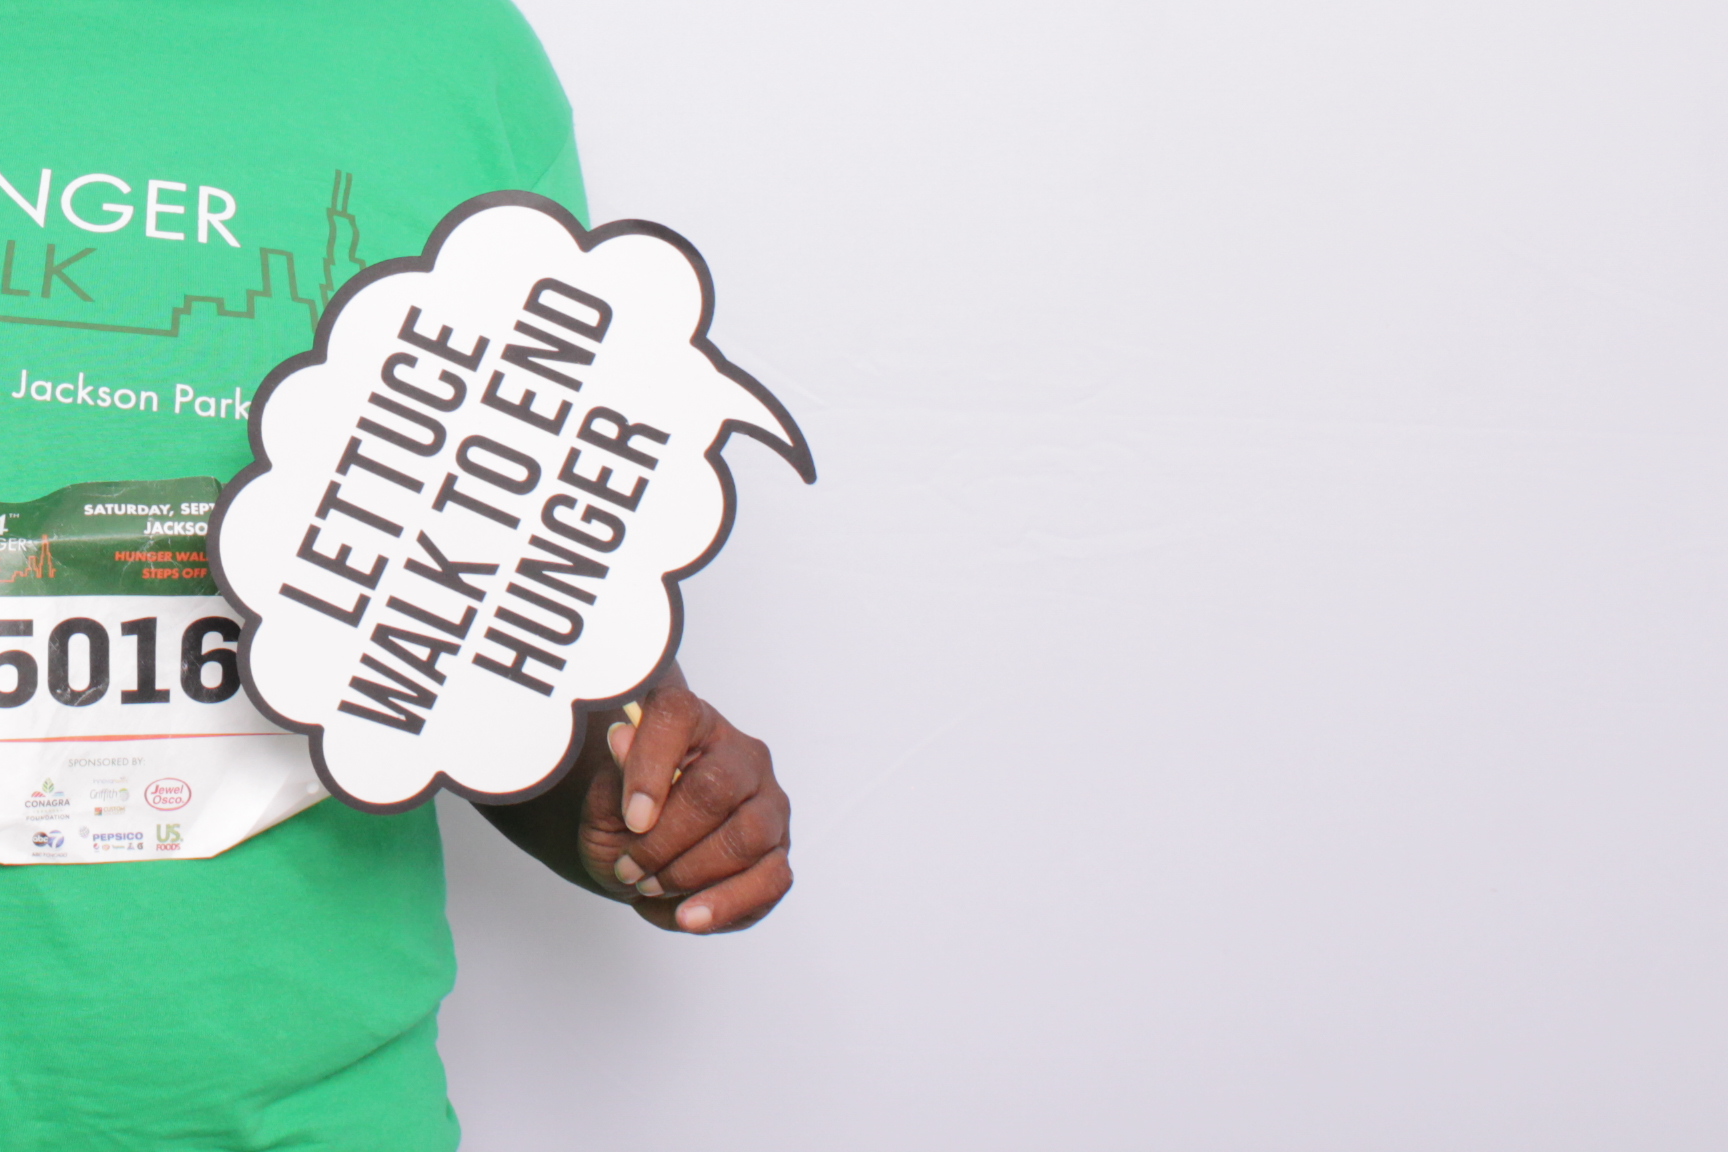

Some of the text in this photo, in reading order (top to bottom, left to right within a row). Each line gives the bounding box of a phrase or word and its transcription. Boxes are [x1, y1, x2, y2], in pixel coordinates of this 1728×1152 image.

[11, 369, 252, 420] Jackson Park
[278, 305, 491, 629] LETTUCE
[84, 503, 175, 517] SATURDAY,
[337, 277, 614, 736] WALK TO END
[143, 521, 208, 536] JACKSO
[115, 551, 208, 562] HUNGER WAL
[471, 406, 671, 698] HUNGER
[142, 568, 208, 579] STEPS OFF
[68, 757, 146, 768] SPONSORED BY:
[89, 788, 118, 802] Griffith
[150, 785, 184, 796] Jewel
[24, 799, 71, 808] CONAGRA
[25, 814, 71, 822] FOUNDATION
[92, 832, 144, 842] PEPSICO
[156, 843, 181, 851] FOODS
